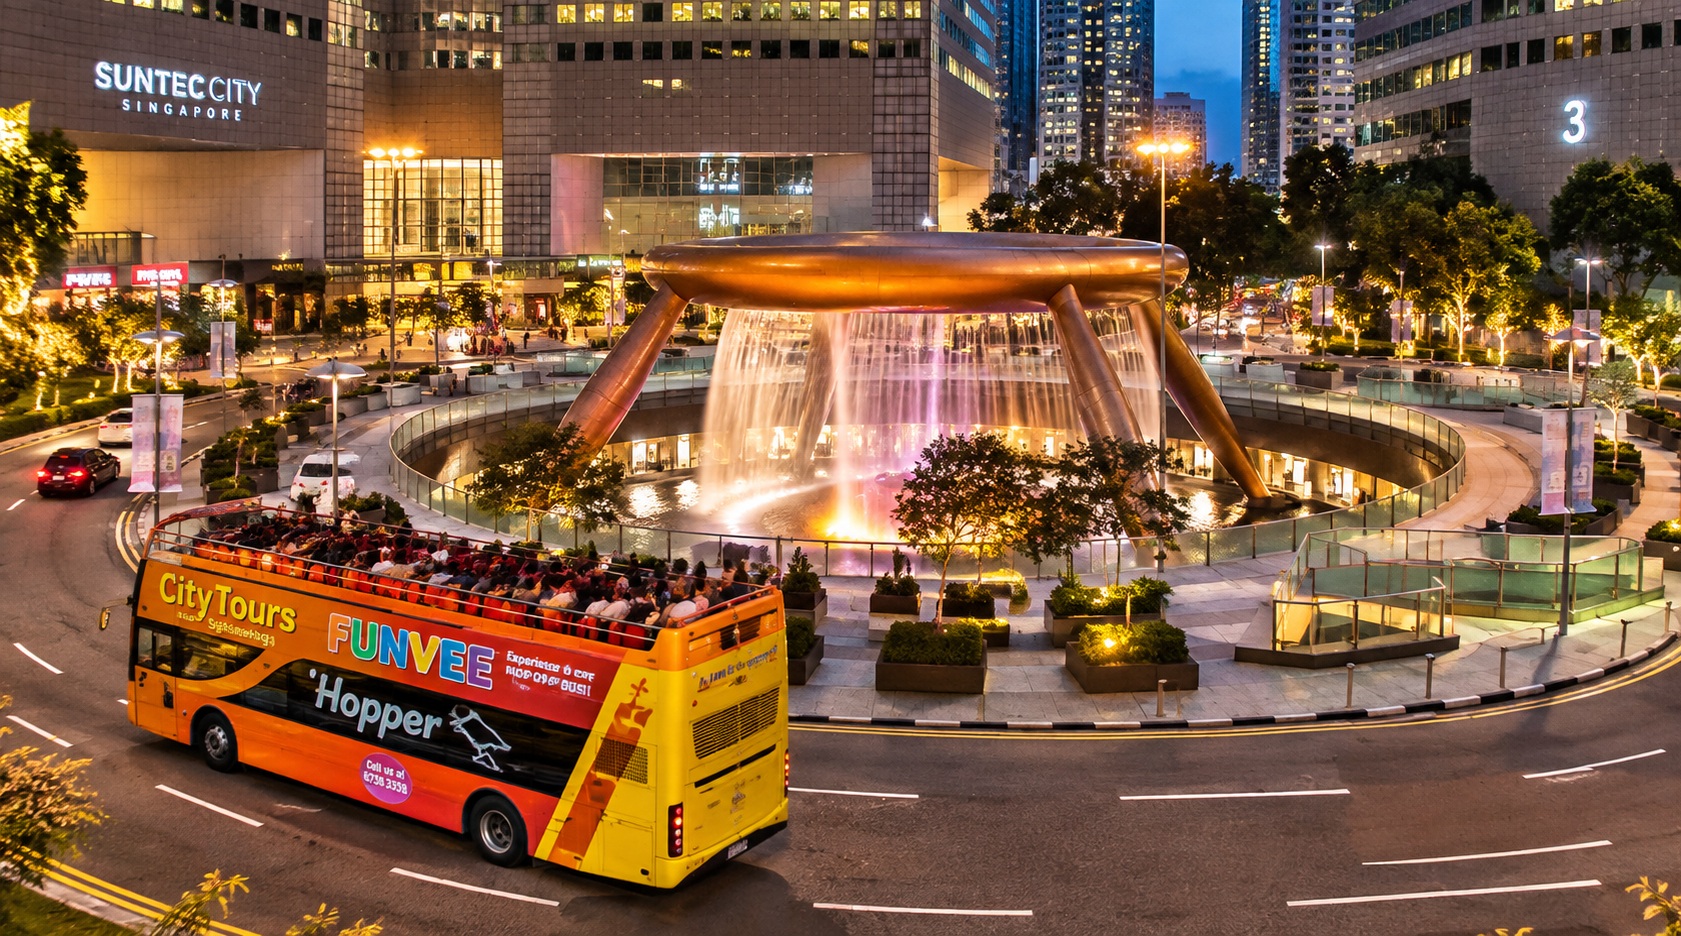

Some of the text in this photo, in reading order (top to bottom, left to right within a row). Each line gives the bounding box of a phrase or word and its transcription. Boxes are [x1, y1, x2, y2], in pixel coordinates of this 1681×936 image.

[122, 98, 242, 122] SINGAPORE
[1563, 99, 1587, 144] 3
[159, 572, 213, 621] City
[215, 583, 297, 633] Tours
[327, 613, 495, 690] FUNVEE
[366, 759, 382, 773] Call
